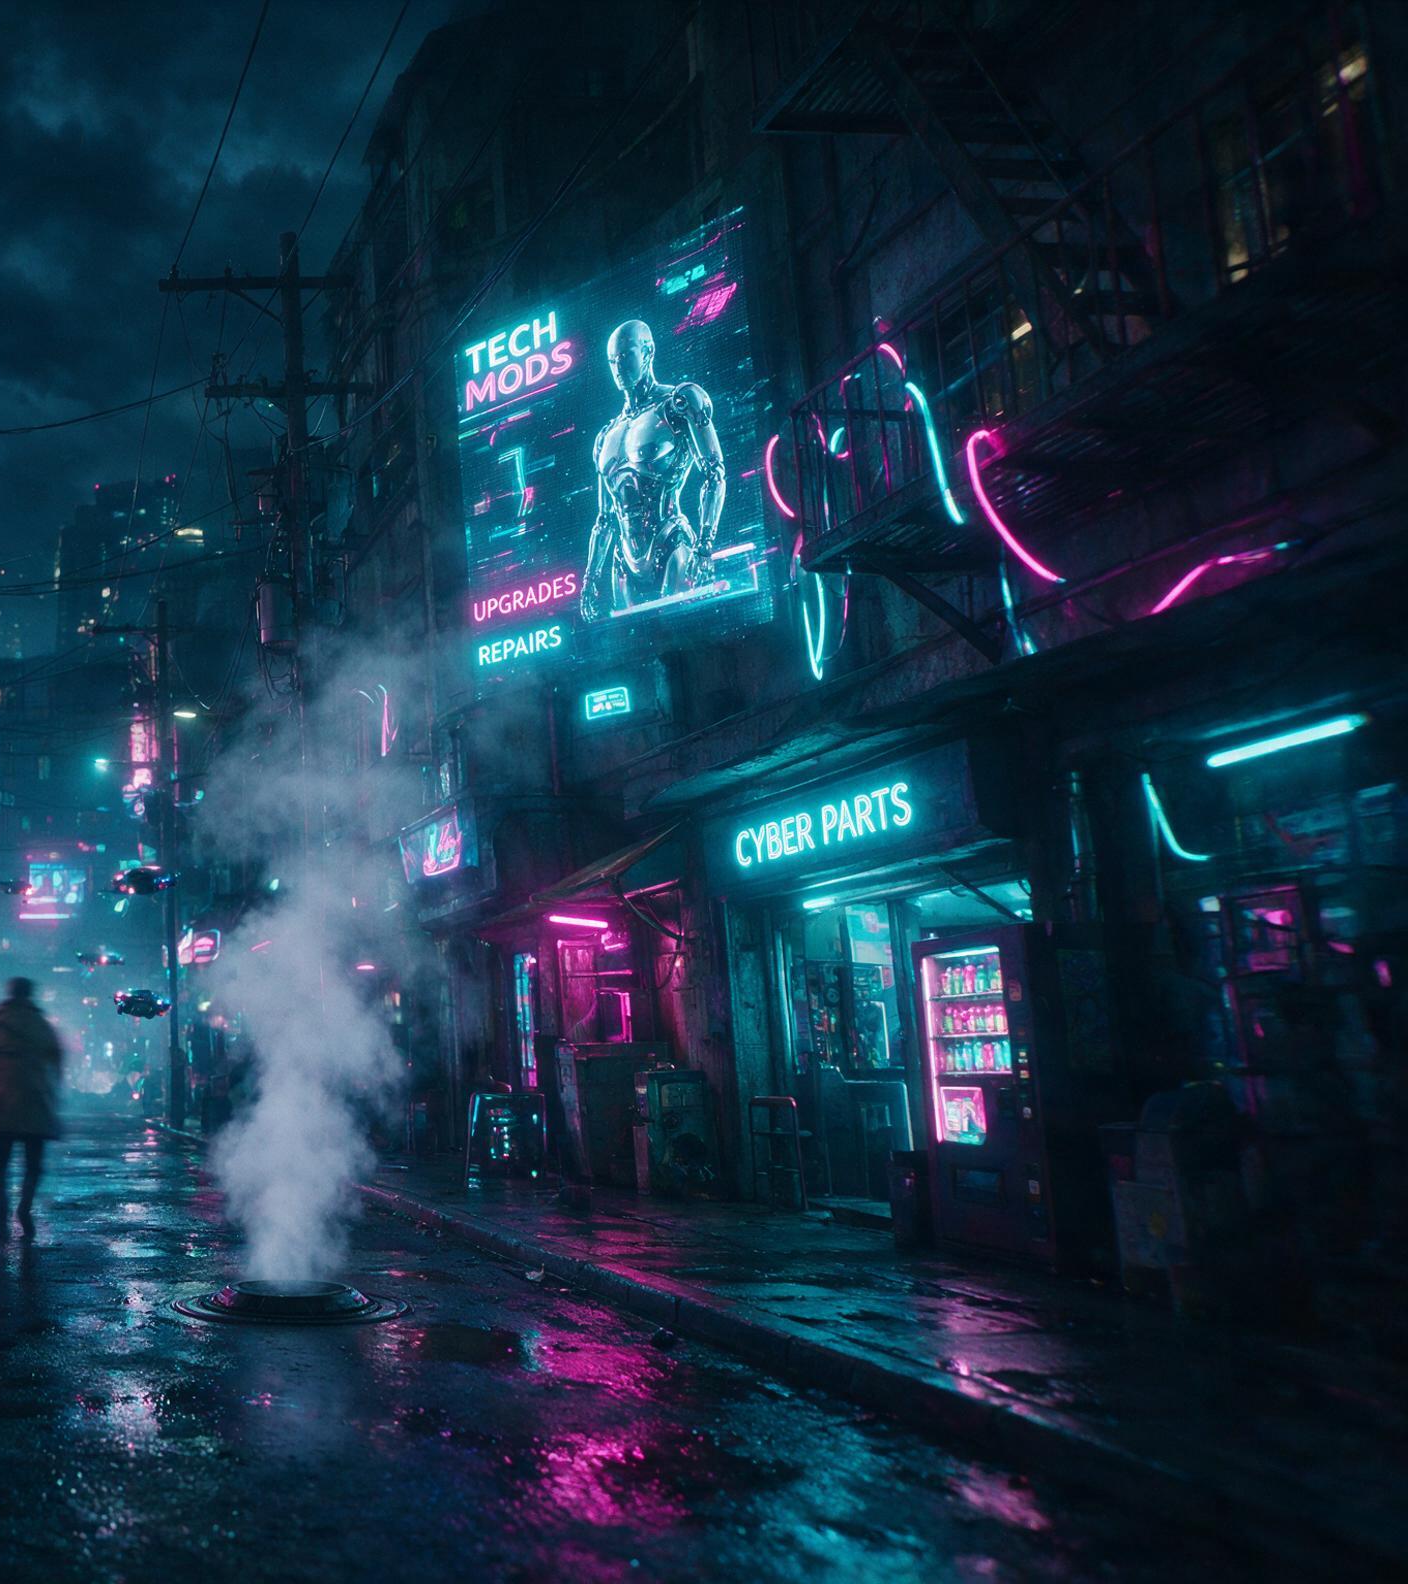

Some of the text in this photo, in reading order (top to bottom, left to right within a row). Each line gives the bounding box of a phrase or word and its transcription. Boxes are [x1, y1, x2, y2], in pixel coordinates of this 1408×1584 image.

[465, 311, 557, 374] TECH
[465, 341, 573, 411] MODS
[473, 573, 576, 622] UPGRADES
[478, 626, 562, 666] REPAIRS
[735, 782, 912, 866] CYBER PARTS
